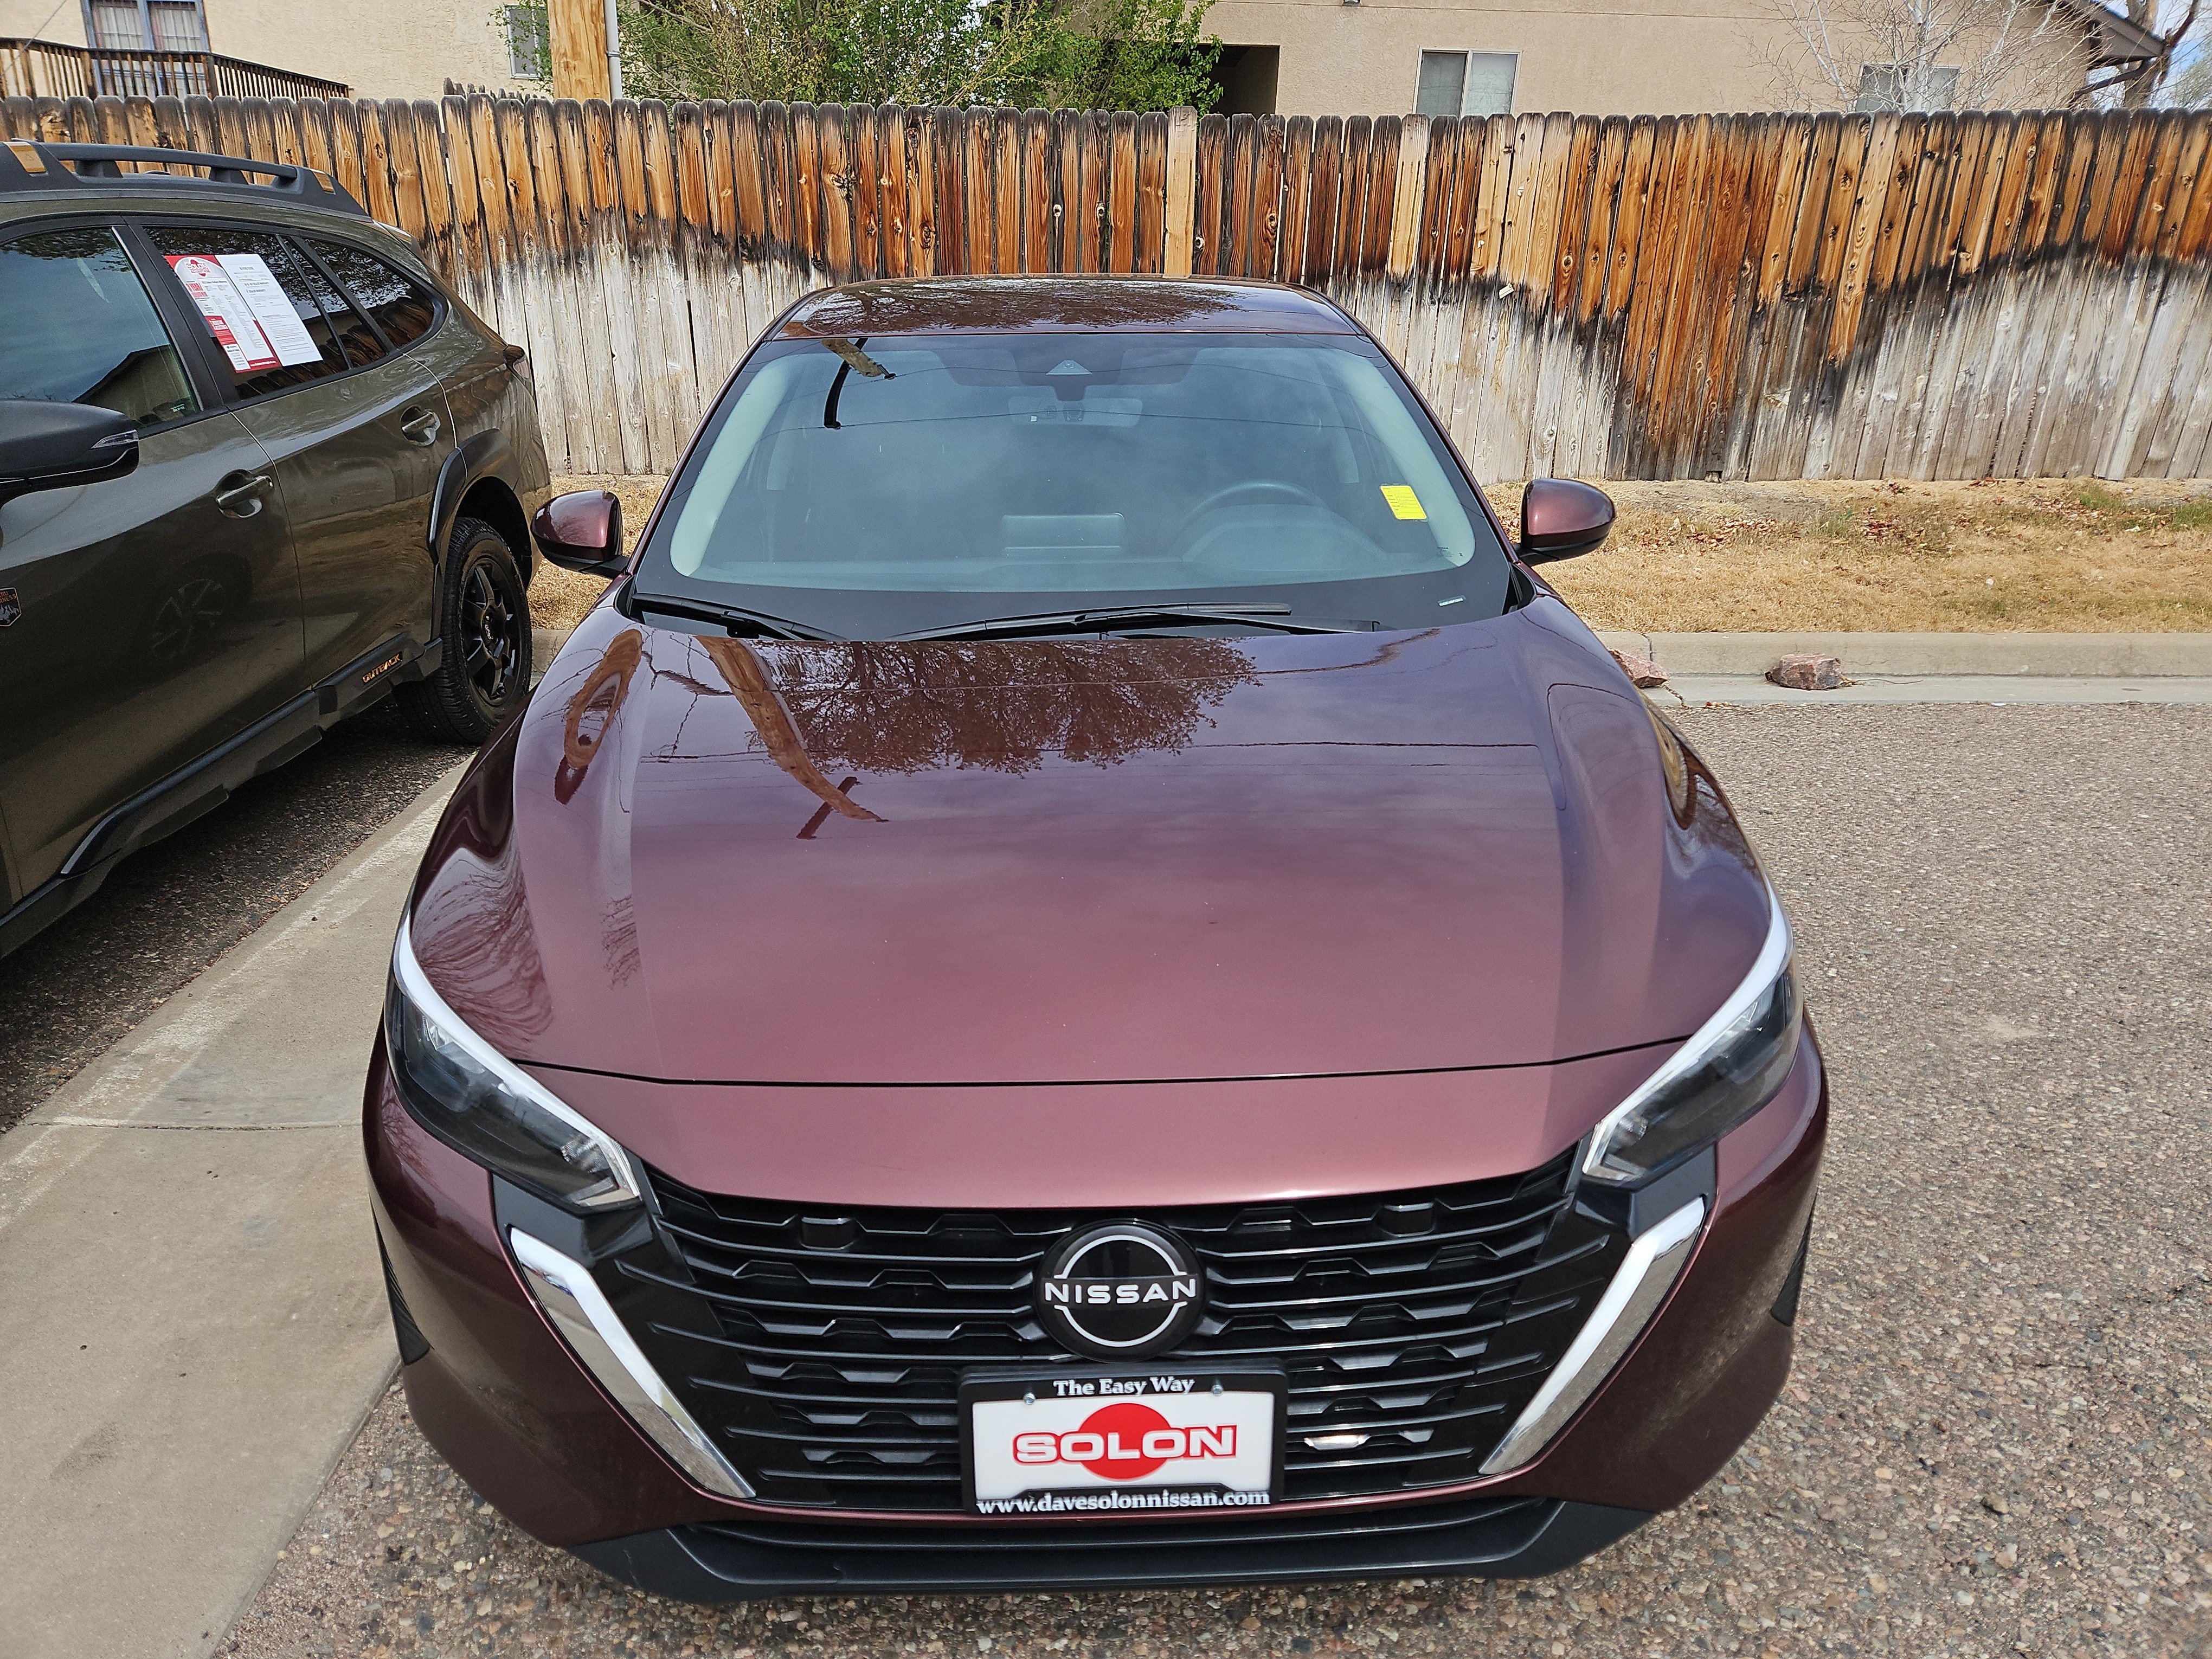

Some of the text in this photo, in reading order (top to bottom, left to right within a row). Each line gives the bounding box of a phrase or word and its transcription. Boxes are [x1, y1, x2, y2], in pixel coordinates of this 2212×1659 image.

[363, 653, 403, 683] OUTBACK
[1044, 1278, 1197, 1304] NISSAN
[1053, 1375, 1195, 1397] The Easy Way
[1013, 1425, 1237, 1465] SOLON
[976, 1490, 1271, 1514] www.davesolonnissan.com
